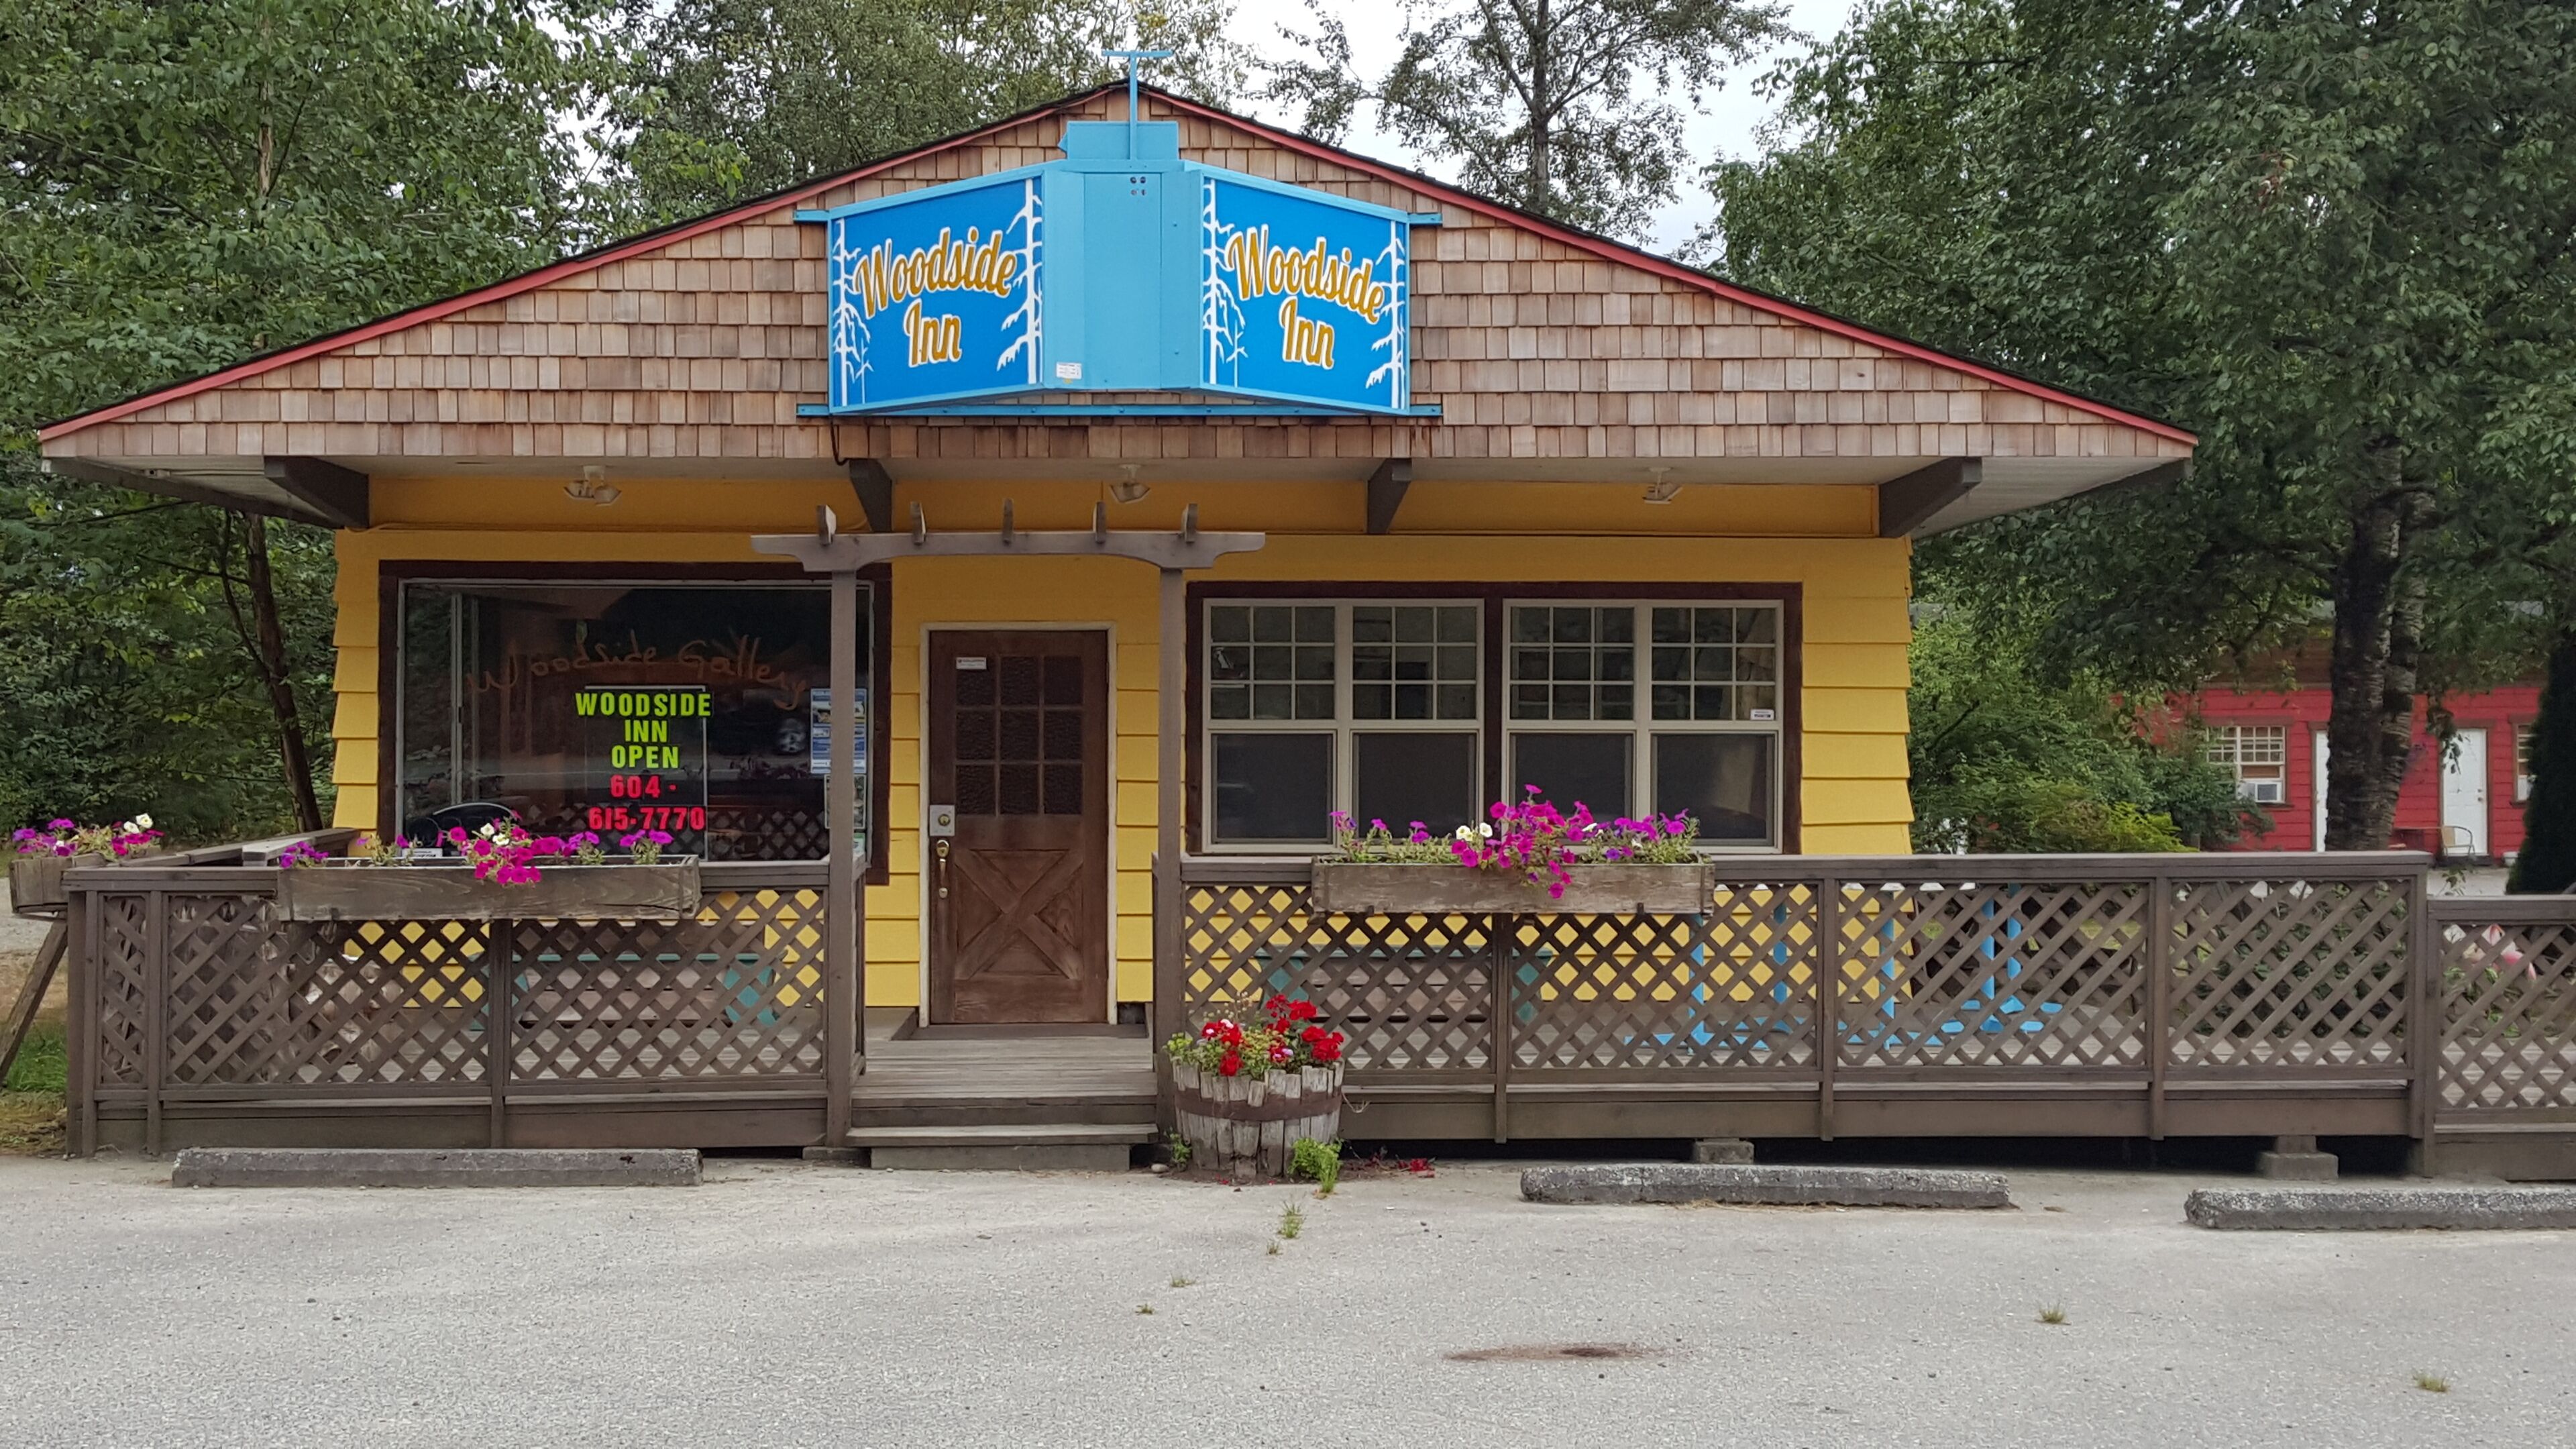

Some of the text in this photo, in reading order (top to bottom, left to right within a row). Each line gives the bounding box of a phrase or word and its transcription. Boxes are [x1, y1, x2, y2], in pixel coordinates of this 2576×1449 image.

[853, 225, 1017, 320] Woodside
[1225, 224, 1385, 324] Woodside
[904, 299, 962, 367] Inn
[1279, 295, 1335, 369] Inn
[466, 628, 806, 710] Woodside Gallery
[575, 692, 711, 716] WOODSIDE
[625, 719, 667, 743] INN
[611, 745, 679, 769] OPEN
[588, 806, 704, 830] 615-7770
